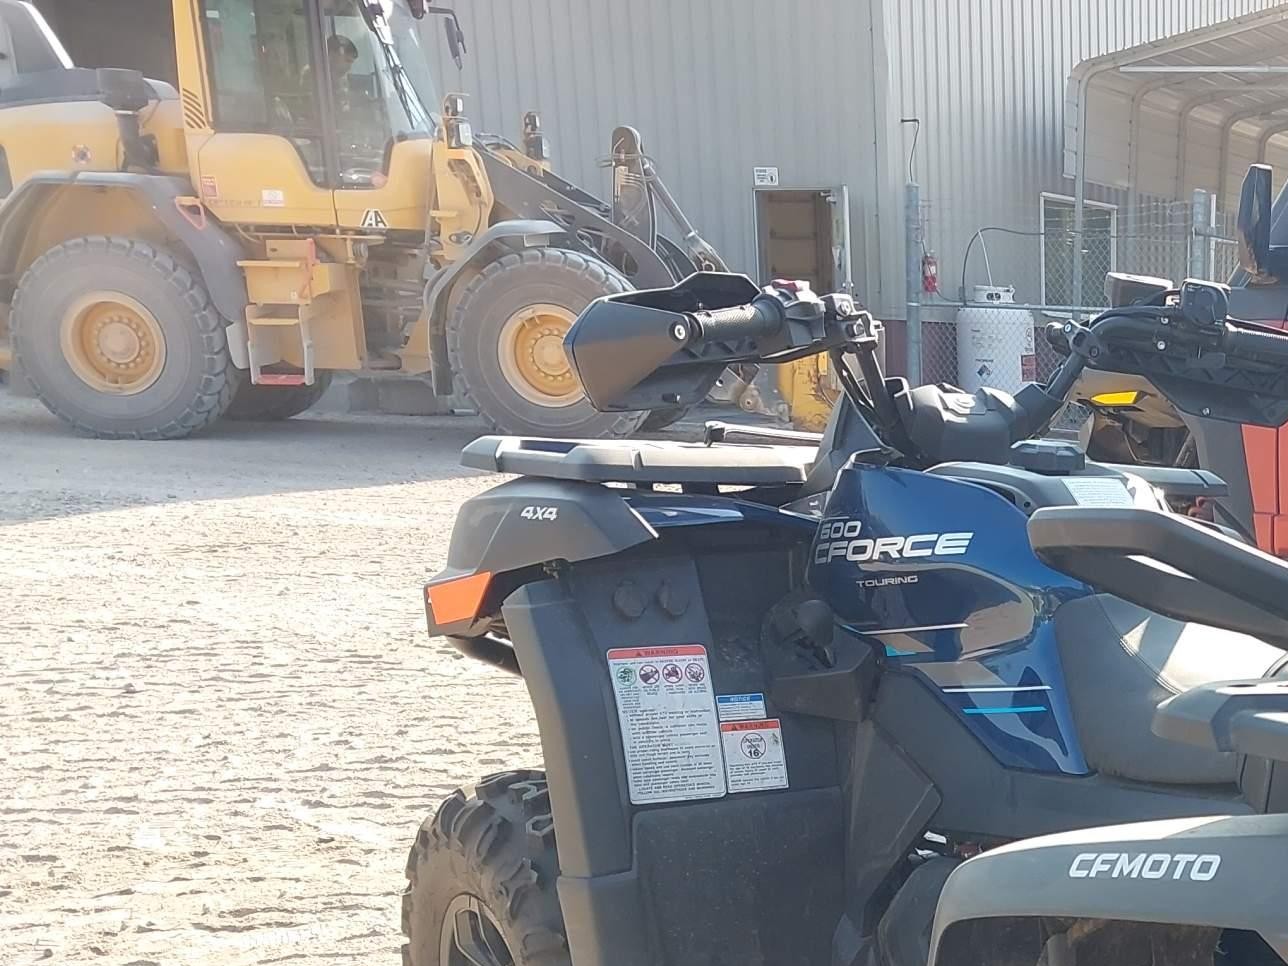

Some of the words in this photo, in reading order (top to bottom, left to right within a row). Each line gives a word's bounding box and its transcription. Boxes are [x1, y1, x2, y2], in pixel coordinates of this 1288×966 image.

[814, 532, 974, 565] CFORCE
[856, 575, 918, 588] TOURING
[747, 749, 759, 757] 16
[1068, 852, 1221, 881] CFMOTO
